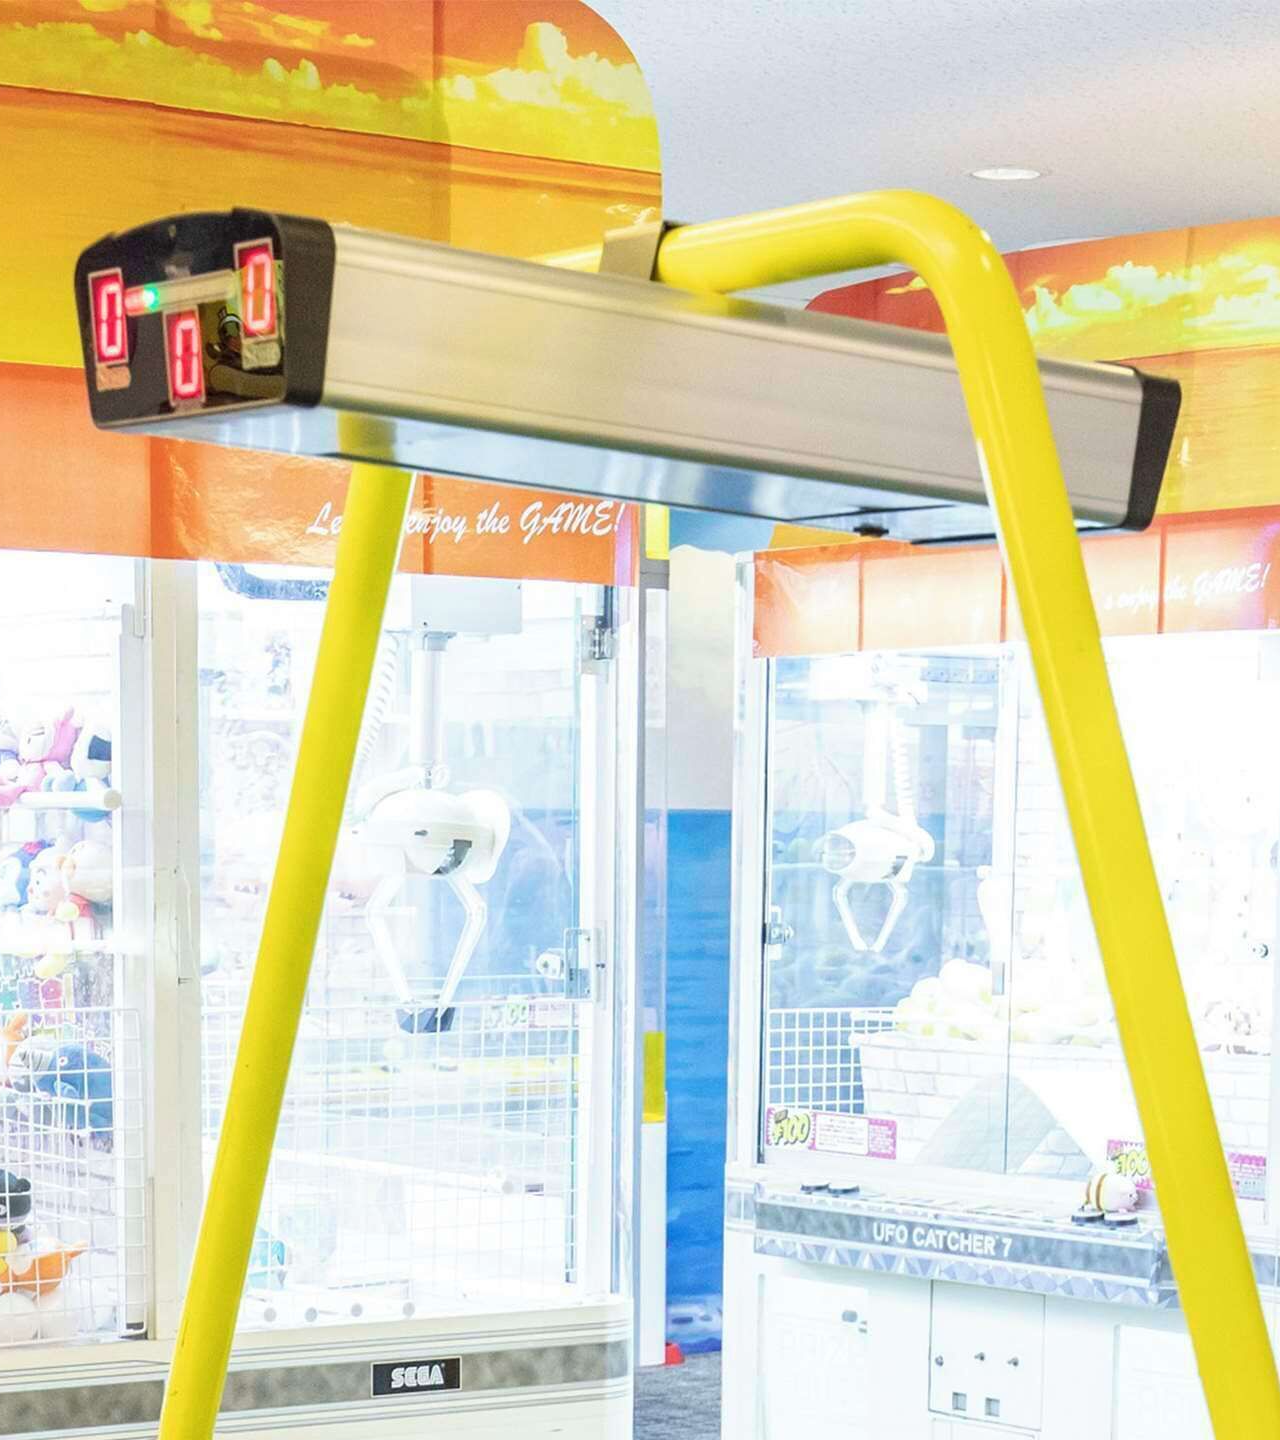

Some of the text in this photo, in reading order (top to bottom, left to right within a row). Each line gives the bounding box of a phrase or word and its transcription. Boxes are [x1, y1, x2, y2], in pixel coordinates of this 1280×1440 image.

[100, 281, 123, 357] 0
[246, 253, 271, 330] 0
[174, 318, 200, 393] 0
[306, 499, 625, 544] Le enjoy the GAME!
[872, 1222, 1013, 1257] UFO CATCHER 7
[391, 1363, 445, 1389] SEGA
